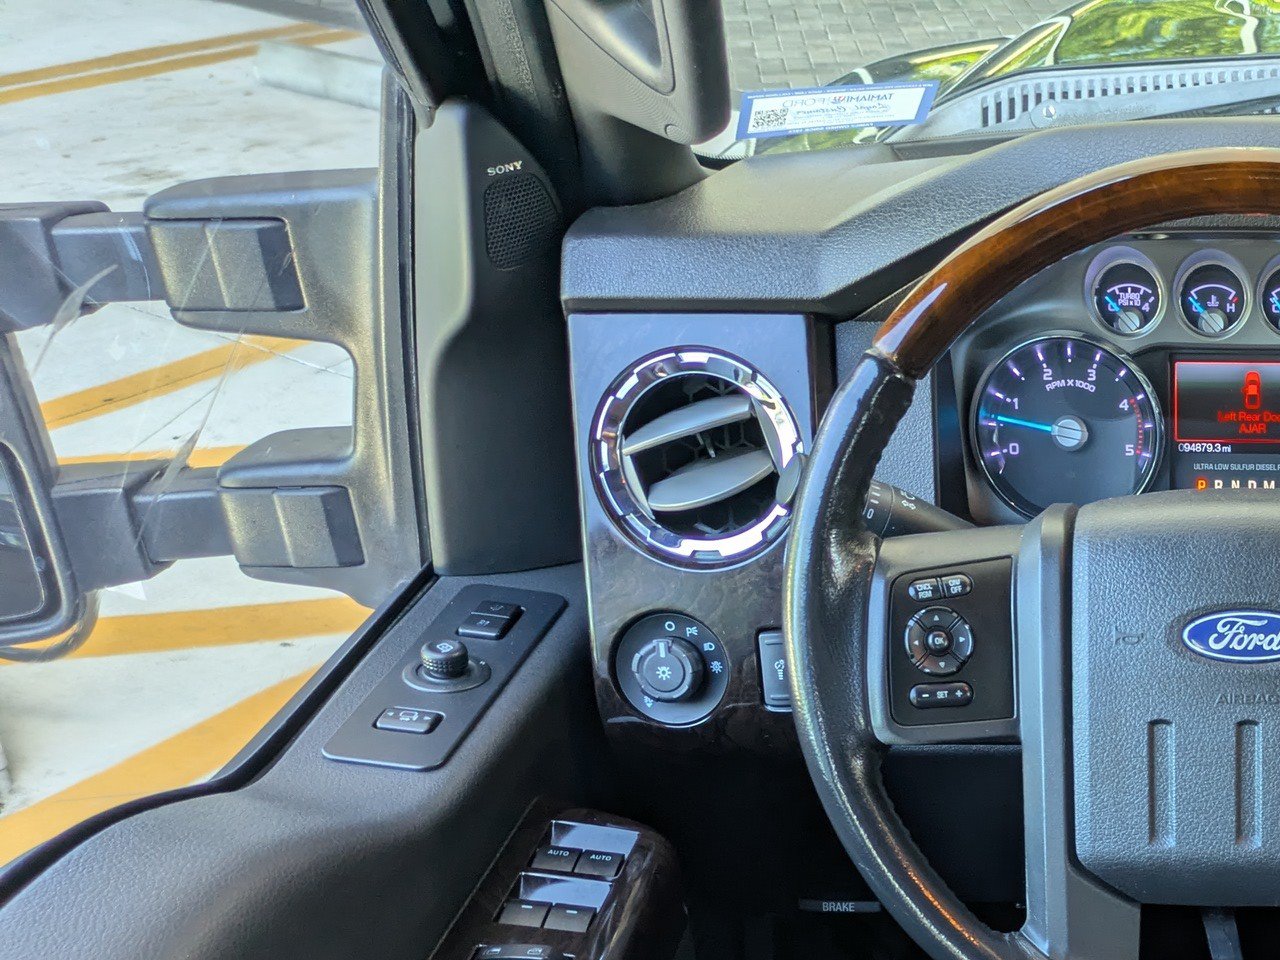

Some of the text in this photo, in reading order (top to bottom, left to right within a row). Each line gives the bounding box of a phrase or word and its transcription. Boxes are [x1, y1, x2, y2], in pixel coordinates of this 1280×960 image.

[487, 160, 523, 176] SONY
[1118, 292, 1141, 301] TURBO
[1118, 299, 1130, 307] PSI
[1141, 303, 1150, 313] 4
[1226, 303, 1236, 313] H
[1043, 369, 1053, 381] 2
[1087, 369, 1097, 381] 3
[1045, 379, 1097, 393] RPM X 1000
[1013, 397, 1019, 410] 1
[1118, 398, 1130, 411] 4
[1217, 411, 1238, 423] Left
[1238, 411, 1261, 423] Rear
[1238, 423, 1267, 434] AJAR
[1009, 442, 1019, 455] 0
[1125, 444, 1135, 456] 5
[1178, 443, 1232, 453] 094879.3 mi
[1193, 463, 1213, 471] ULTRA
[1214, 463, 1229, 471] LOW
[1230, 463, 1255, 471] SULFUR
[1198, 479, 1206, 489] P
[918, 590, 933, 599] RSM
[950, 586, 963, 594] OFF
[934, 636, 945, 646] OK
[936, 691, 948, 699] SET
[1214, 692, 1280, 705] AIRBAG
[547, 849, 570, 857] AUTO
[590, 853, 612, 862] AUTO
[822, 901, 856, 912] BRAKE
